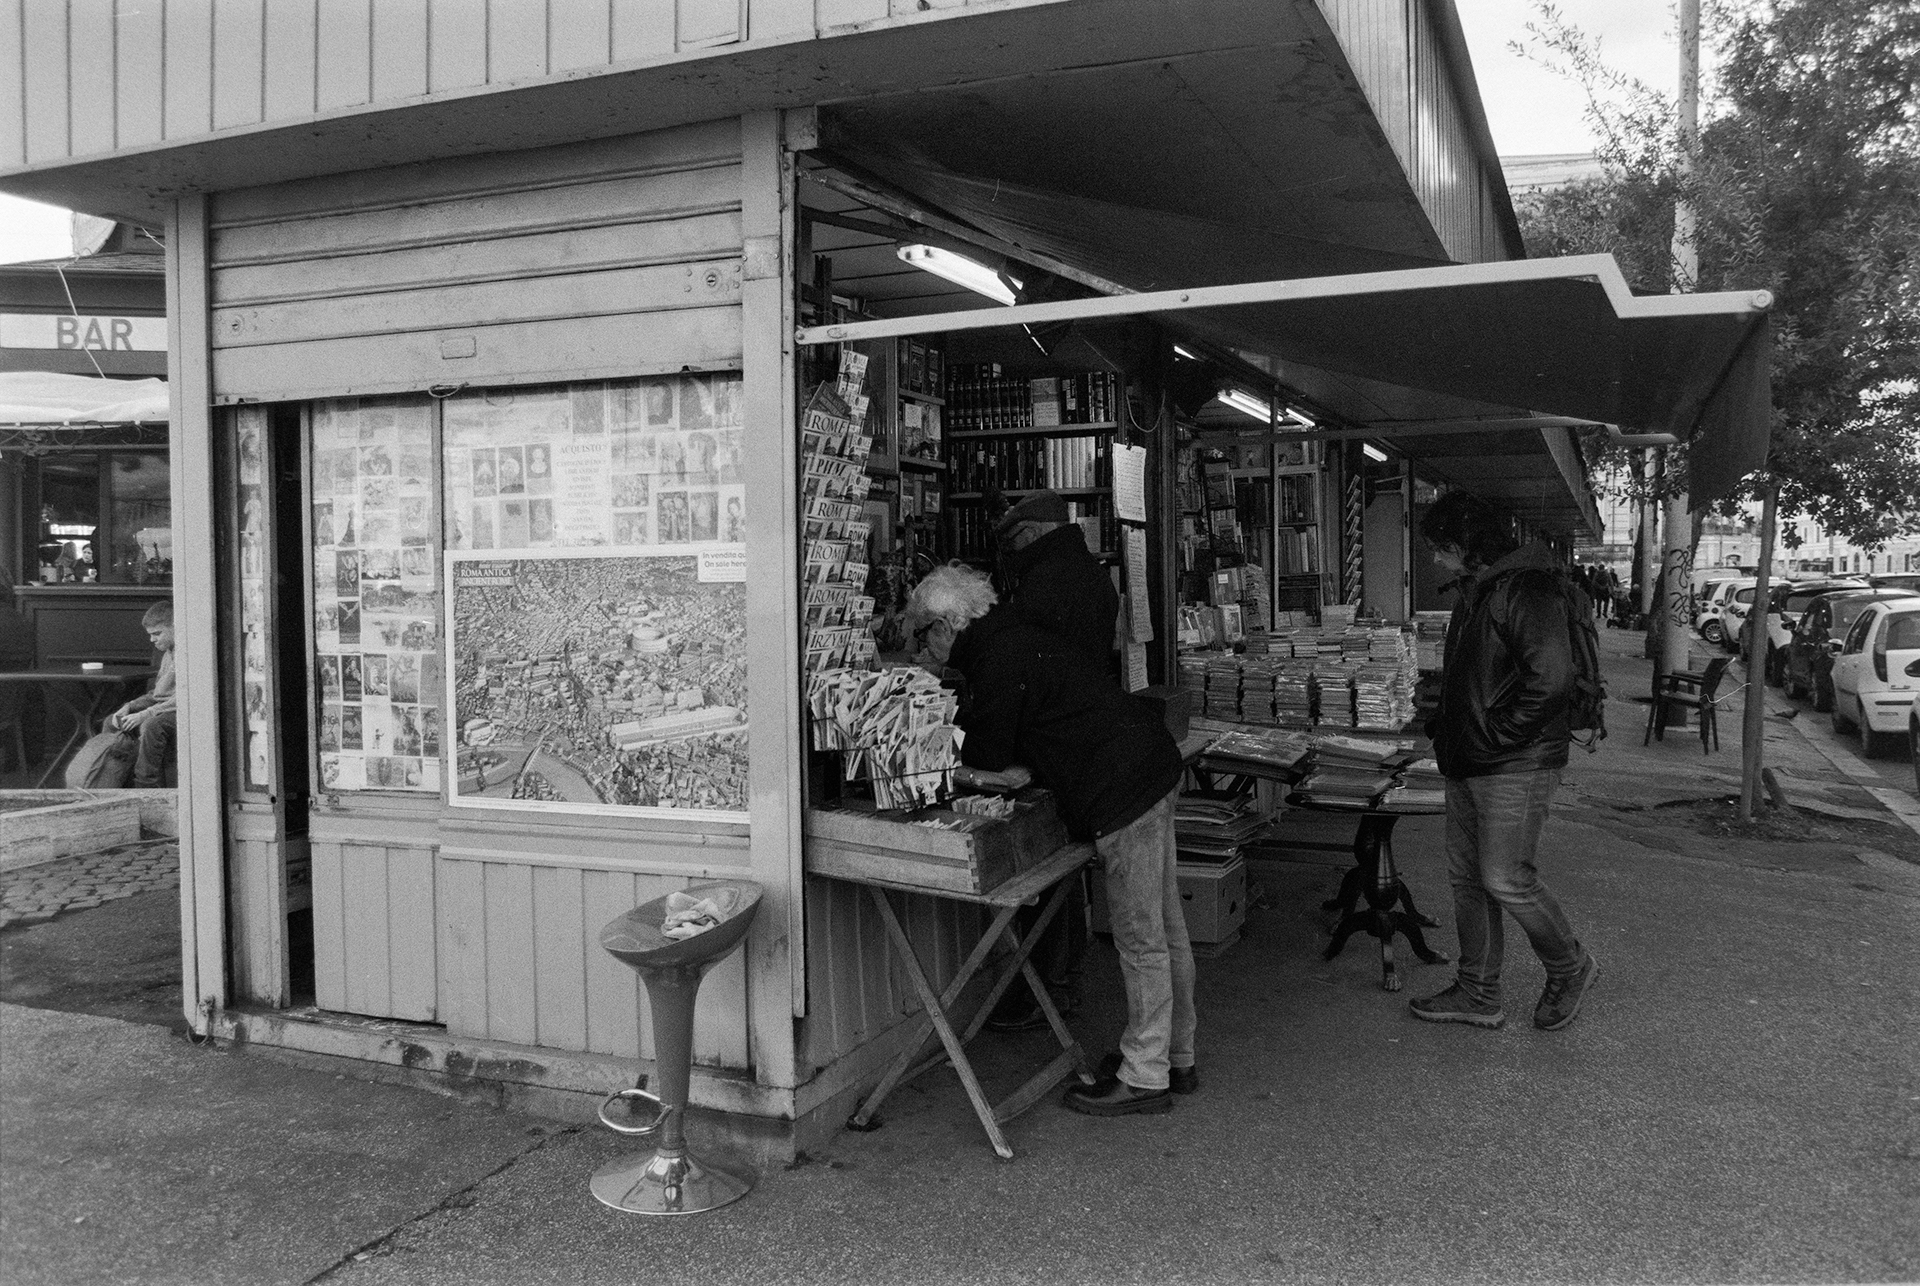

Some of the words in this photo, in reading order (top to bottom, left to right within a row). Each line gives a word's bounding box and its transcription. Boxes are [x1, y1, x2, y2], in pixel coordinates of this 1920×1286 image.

[57, 317, 133, 351] BAR
[812, 415, 849, 434] ROME
[560, 444, 601, 455] ACQUISTO
[818, 502, 843, 518] ROM
[848, 529, 867, 541] ROMA
[815, 545, 846, 560] ROME
[460, 569, 483, 577] ROMA
[483, 568, 512, 577] ANTICA
[814, 589, 847, 606] ROMA
[814, 632, 848, 648] RZYM
